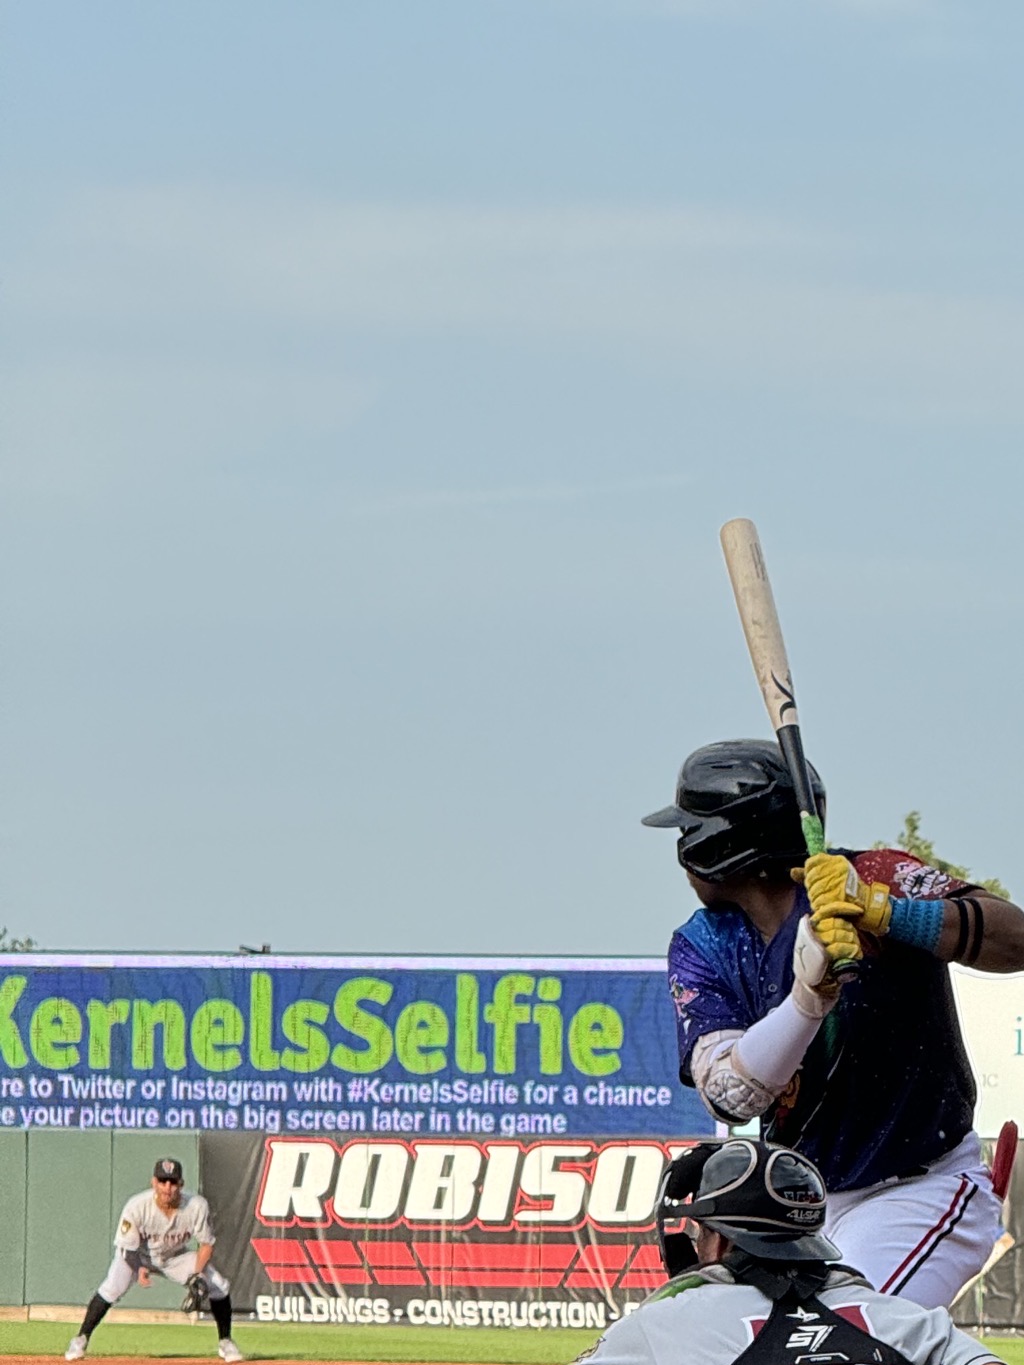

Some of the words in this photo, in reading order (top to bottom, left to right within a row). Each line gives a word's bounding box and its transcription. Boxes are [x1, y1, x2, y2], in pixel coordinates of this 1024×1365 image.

[29, 1074, 52, 1098] to
[58, 1074, 136, 1100] Twitter
[141, 1079, 165, 1100] or
[171, 1076, 287, 1106] Instagram
[293, 1077, 342, 1103] with
[348, 1078, 518, 1104] #KernelsSelfie
[524, 1080, 560, 1105] for
[563, 1087, 578, 1105] a
[584, 1082, 671, 1106] chance
[0, 1106, 15, 1126] e
[20, 1106, 73, 1130] your
[80, 1103, 159, 1129] picture
[165, 1108, 195, 1128] on
[201, 1104, 237, 1128] the
[244, 1104, 281, 1134] big
[287, 1111, 365, 1131] screen
[372, 1108, 424, 1131] later
[430, 1108, 450, 1131] in
[456, 1108, 494, 1132] the
[500, 1112, 567, 1137] game
[257, 1138, 693, 1233] ROBISO
[256, 1295, 390, 1324] BUILDINGS
[407, 1299, 606, 1329] CONSTRUCTION
